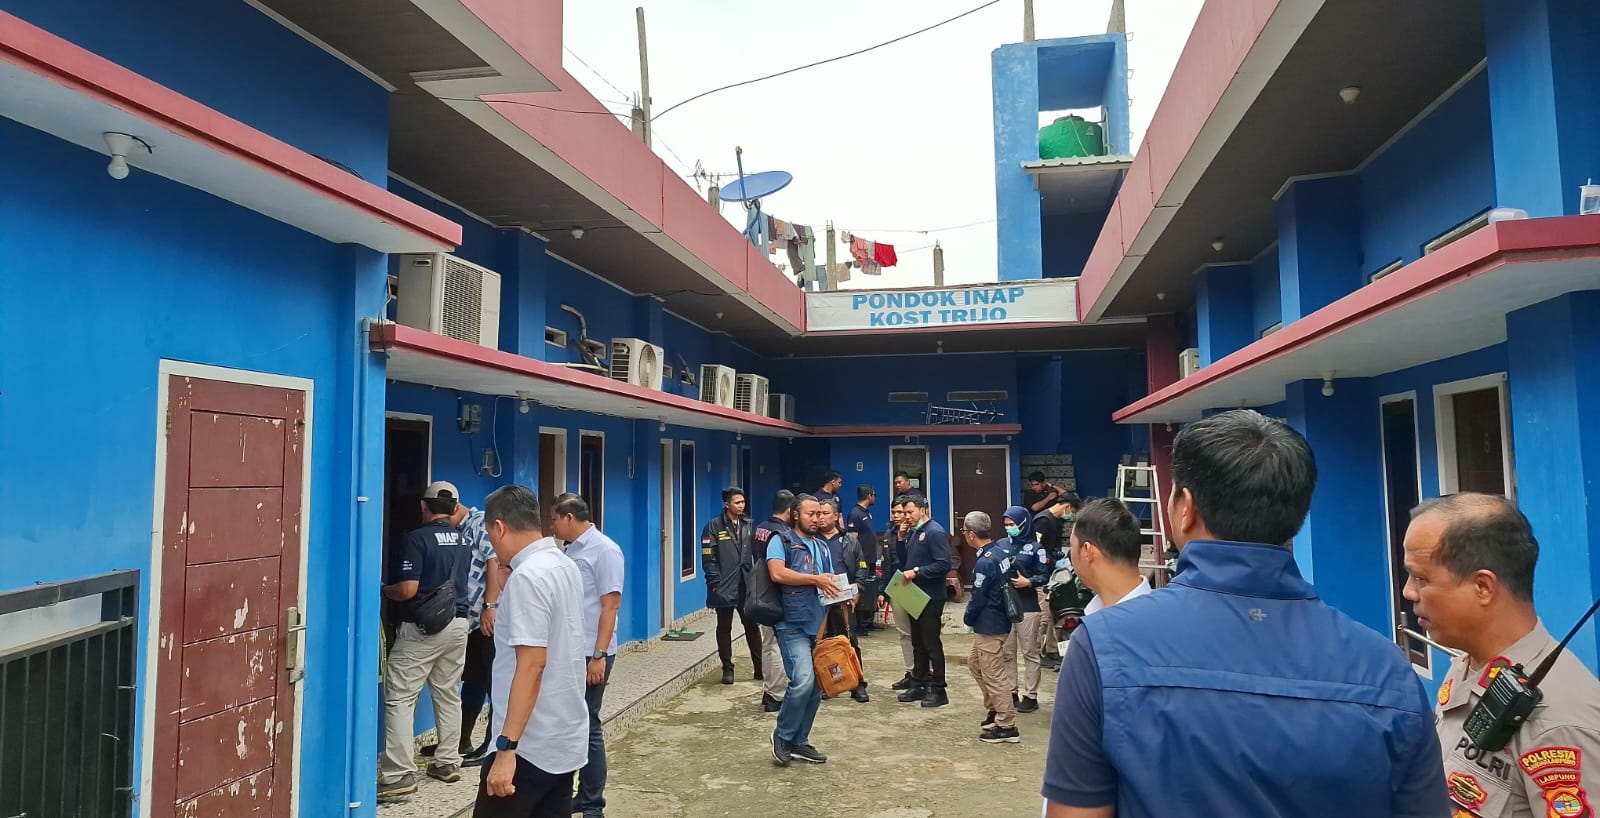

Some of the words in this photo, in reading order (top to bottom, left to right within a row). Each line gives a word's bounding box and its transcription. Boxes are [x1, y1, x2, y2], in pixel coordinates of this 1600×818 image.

[852, 291, 957, 310] PONDOK
[964, 287, 1025, 305] INAP
[869, 310, 932, 327] KOST
[938, 307, 1007, 324] TRIJO
[1455, 737, 1511, 780] POLRI
[1521, 750, 1576, 767] POLRESTA
[1539, 774, 1576, 784] LAMPUNG
